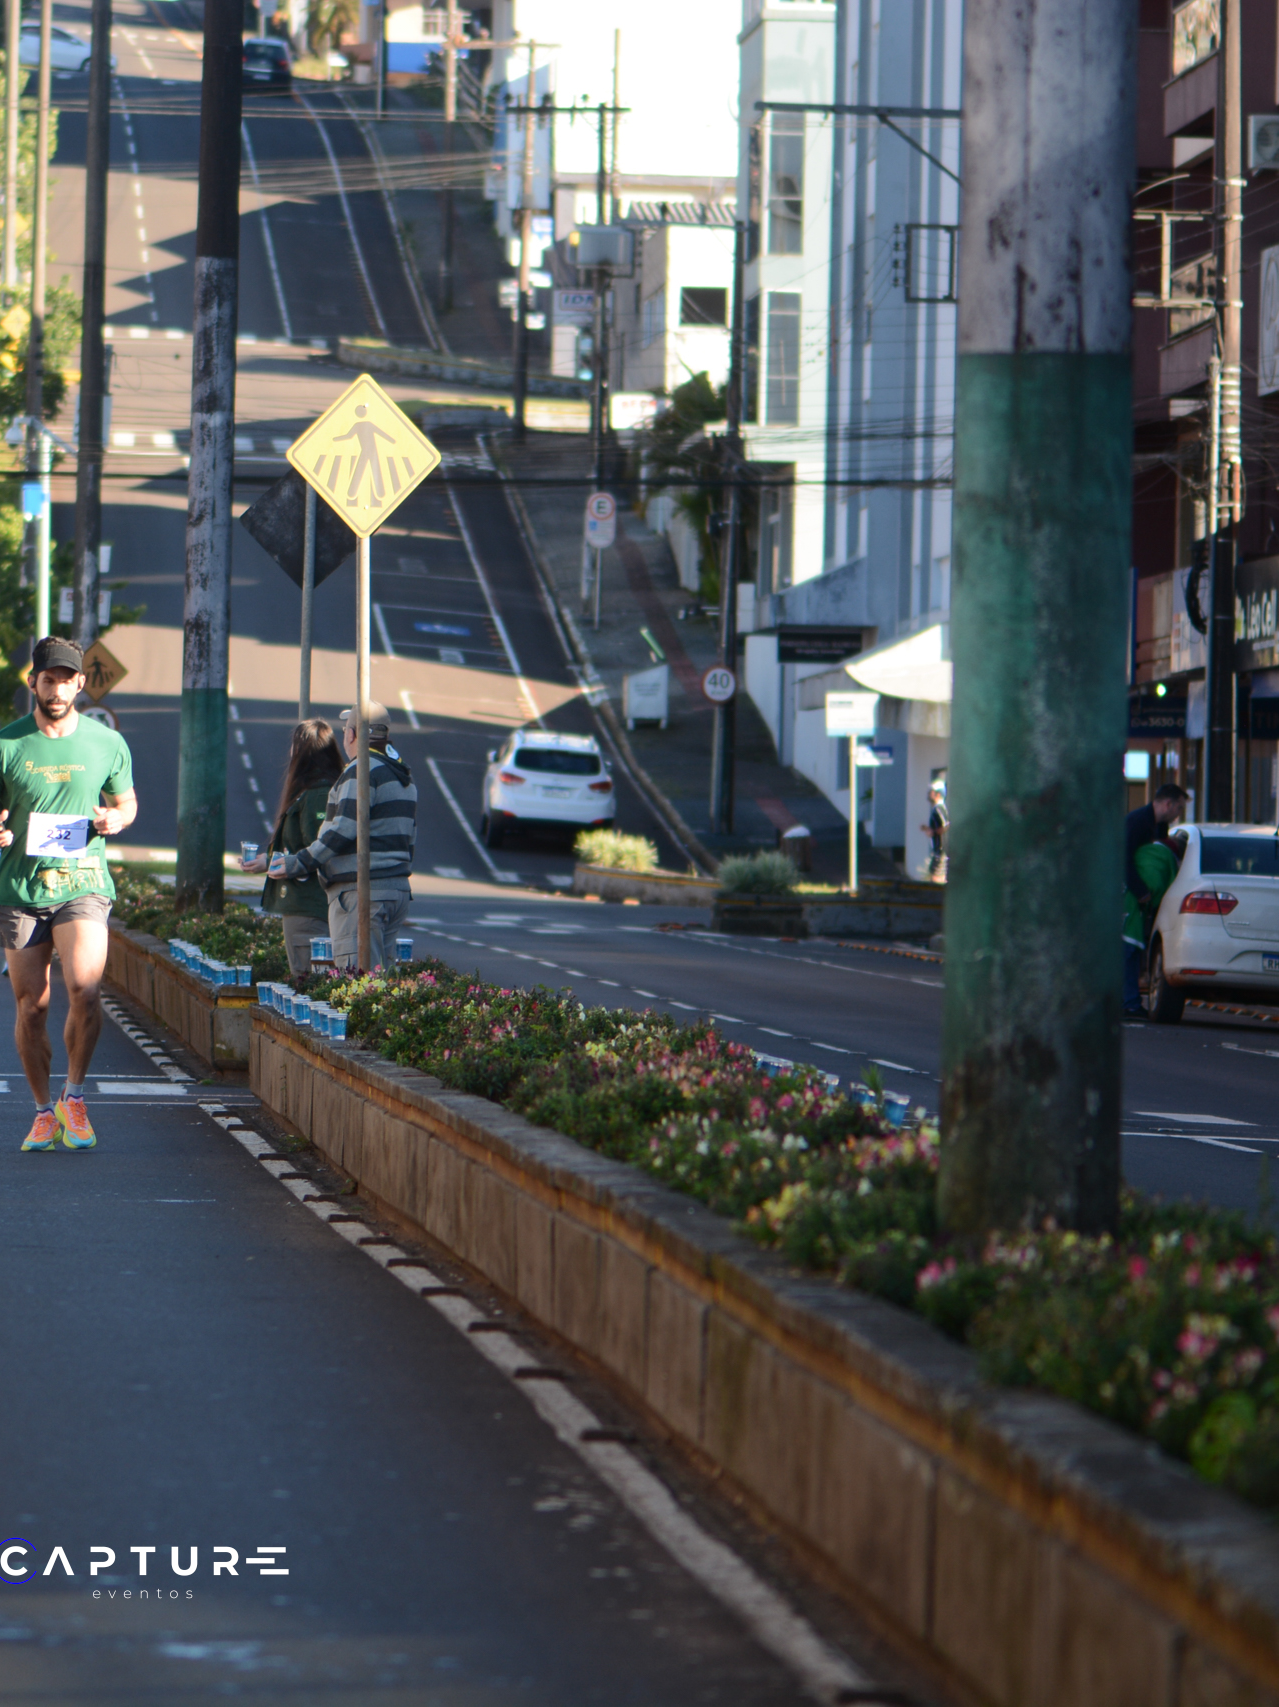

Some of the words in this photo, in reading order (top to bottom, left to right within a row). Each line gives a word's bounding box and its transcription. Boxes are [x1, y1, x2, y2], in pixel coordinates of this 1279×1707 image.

[596, 501, 608, 514] E
[708, 672, 731, 689] 40
[48, 830, 71, 840] 232
